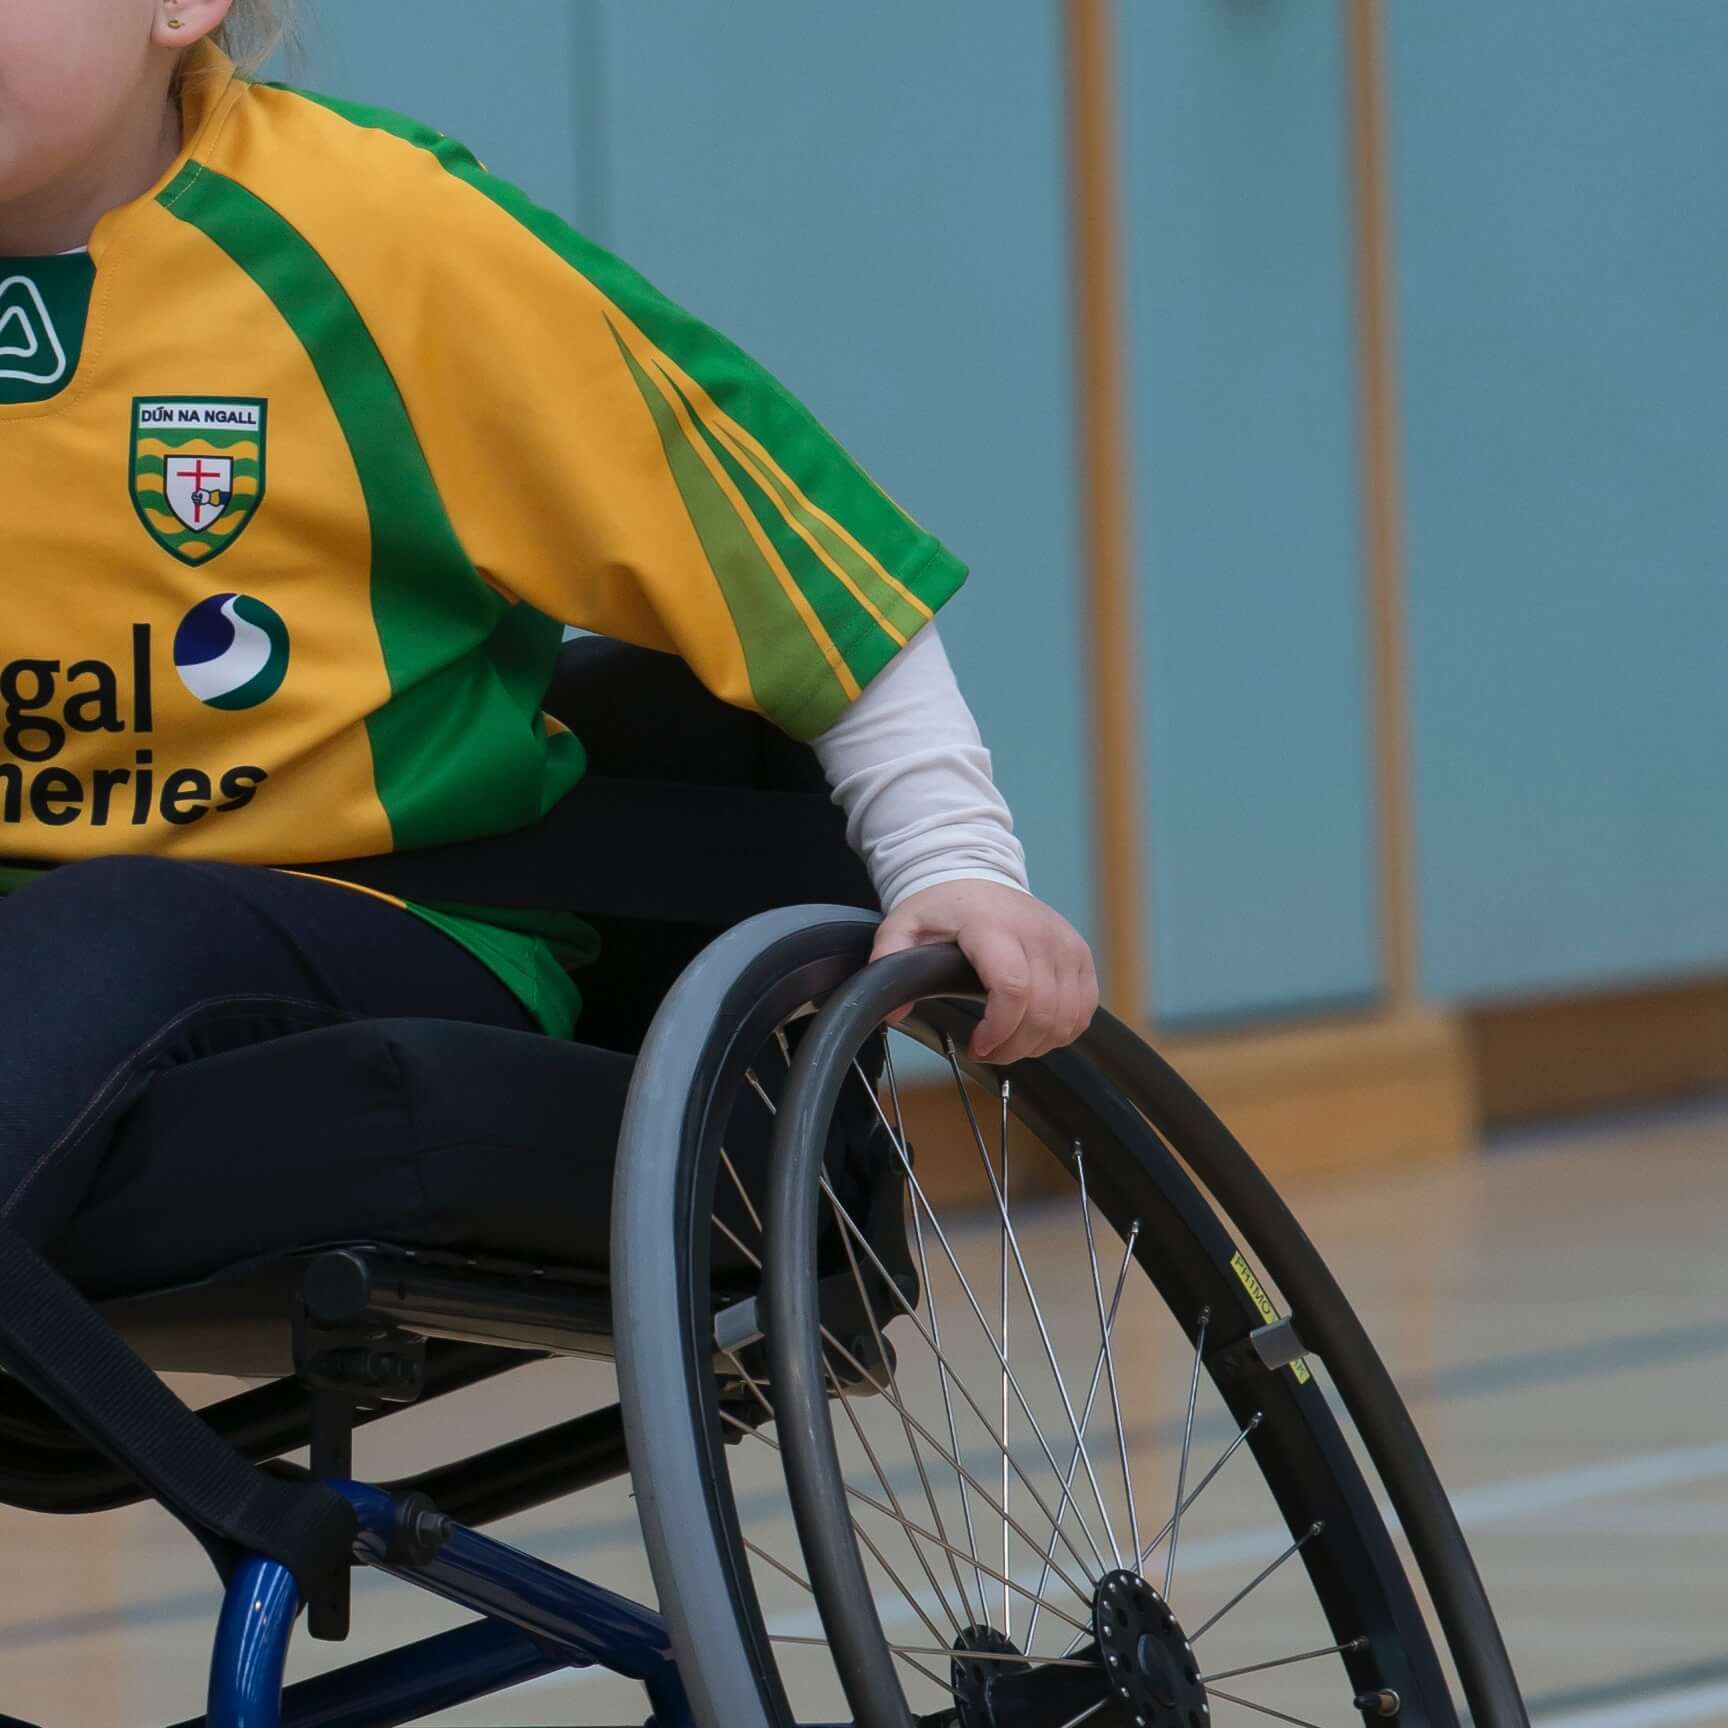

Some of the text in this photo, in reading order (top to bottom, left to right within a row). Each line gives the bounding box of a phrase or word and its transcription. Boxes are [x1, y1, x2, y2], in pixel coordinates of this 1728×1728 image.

[140, 406, 257, 425] DÚN NA NGALL
